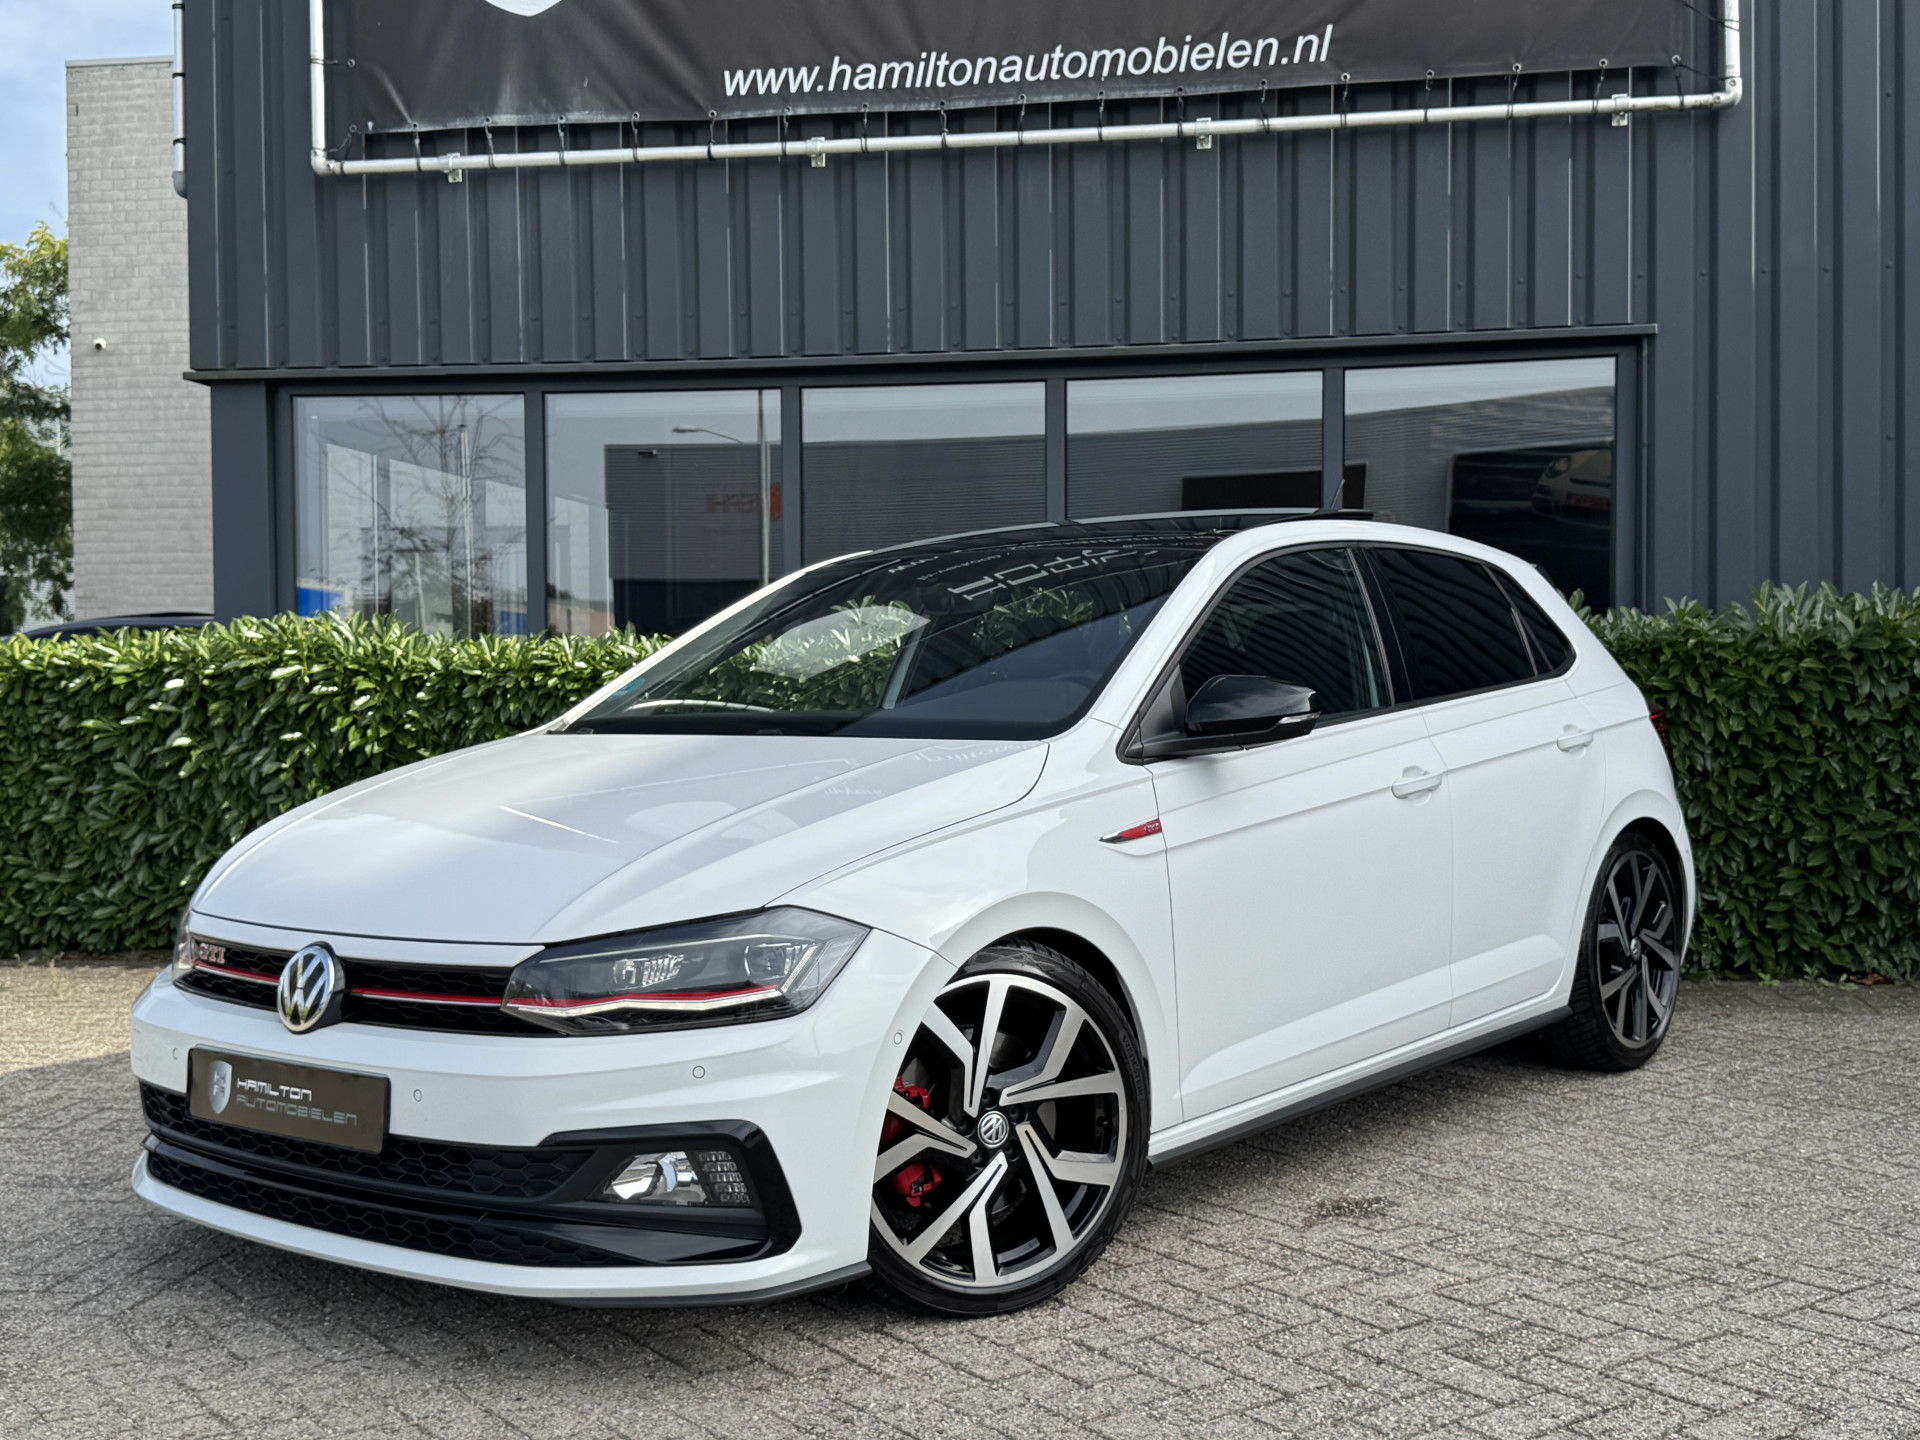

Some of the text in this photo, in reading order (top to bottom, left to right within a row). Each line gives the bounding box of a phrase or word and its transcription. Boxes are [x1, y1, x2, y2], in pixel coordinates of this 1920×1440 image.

[723, 23, 1334, 97] www.hamiltonautomobielen.nl
[198, 942, 227, 965] GTI
[236, 1077, 312, 1102] HAMILTON
[235, 1093, 358, 1126] AUTOMOBIELEN
